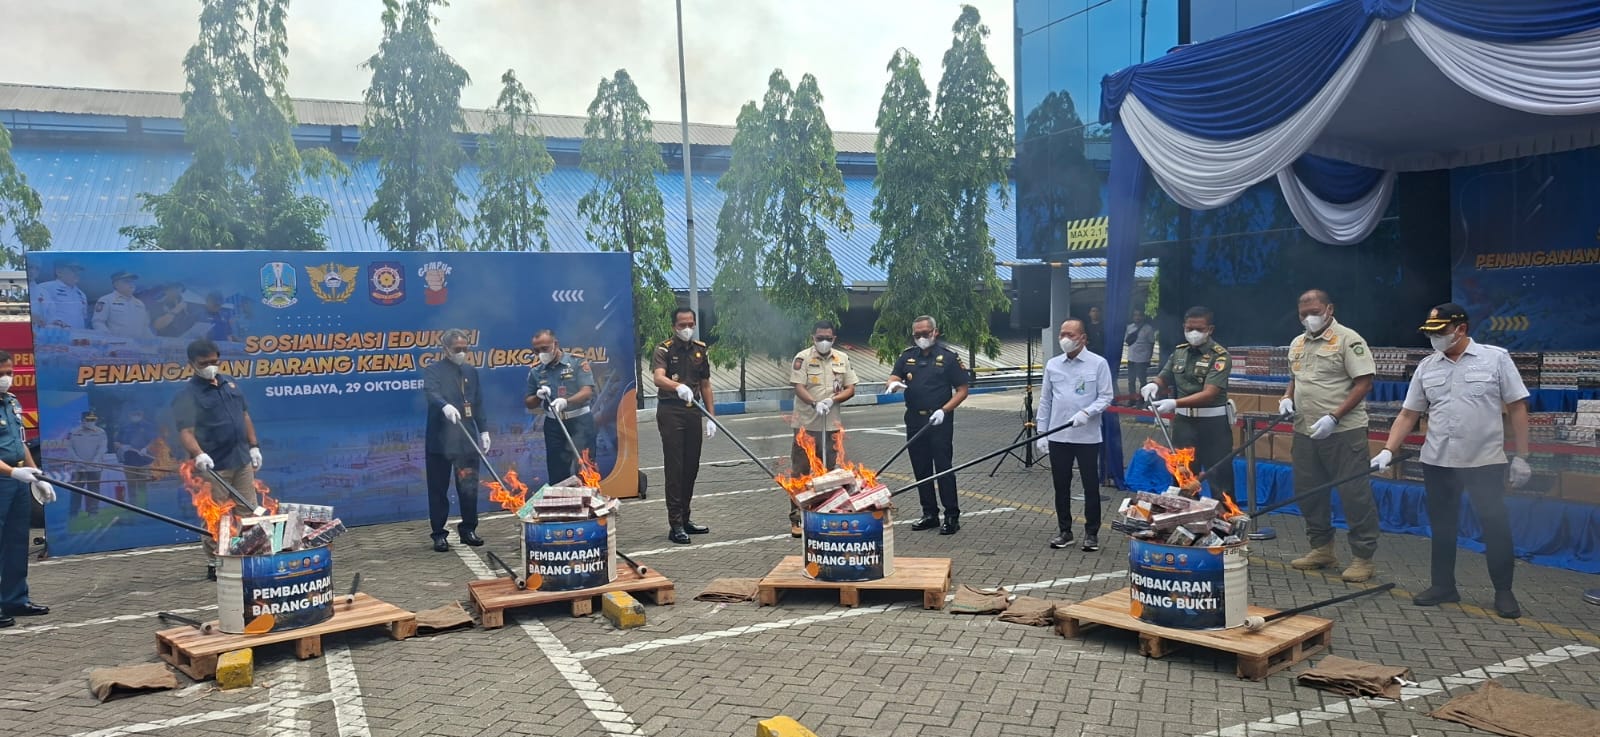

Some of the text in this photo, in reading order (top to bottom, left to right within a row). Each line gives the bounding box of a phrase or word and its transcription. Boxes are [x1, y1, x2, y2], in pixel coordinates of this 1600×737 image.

[1070, 230, 1088, 239] MAX
[418, 261, 452, 277] GEMPUR
[1476, 248, 1600, 270] PENANGANAN
[245, 328, 479, 355] SOSIALISASI EDUKSI
[77, 358, 253, 386] PENANGAAN
[255, 355, 354, 378] BARANG
[357, 353, 416, 373] KENA
[419, 350, 486, 369] CAI
[265, 378, 424, 397] SURABAYA, 29 OKTOBER
[529, 547, 600, 561] PEMBAKARAN
[807, 538, 875, 552] PEMBAKARAN
[529, 560, 603, 575] BARANG BUKTI
[807, 552, 879, 566] BARANG BUKTI
[253, 576, 331, 599] PEMBAKARAN
[1131, 572, 1211, 593] PEMBAKARAN
[252, 589, 333, 616] BARANG BUKTI
[1131, 588, 1217, 610] BARANG BUKTI
